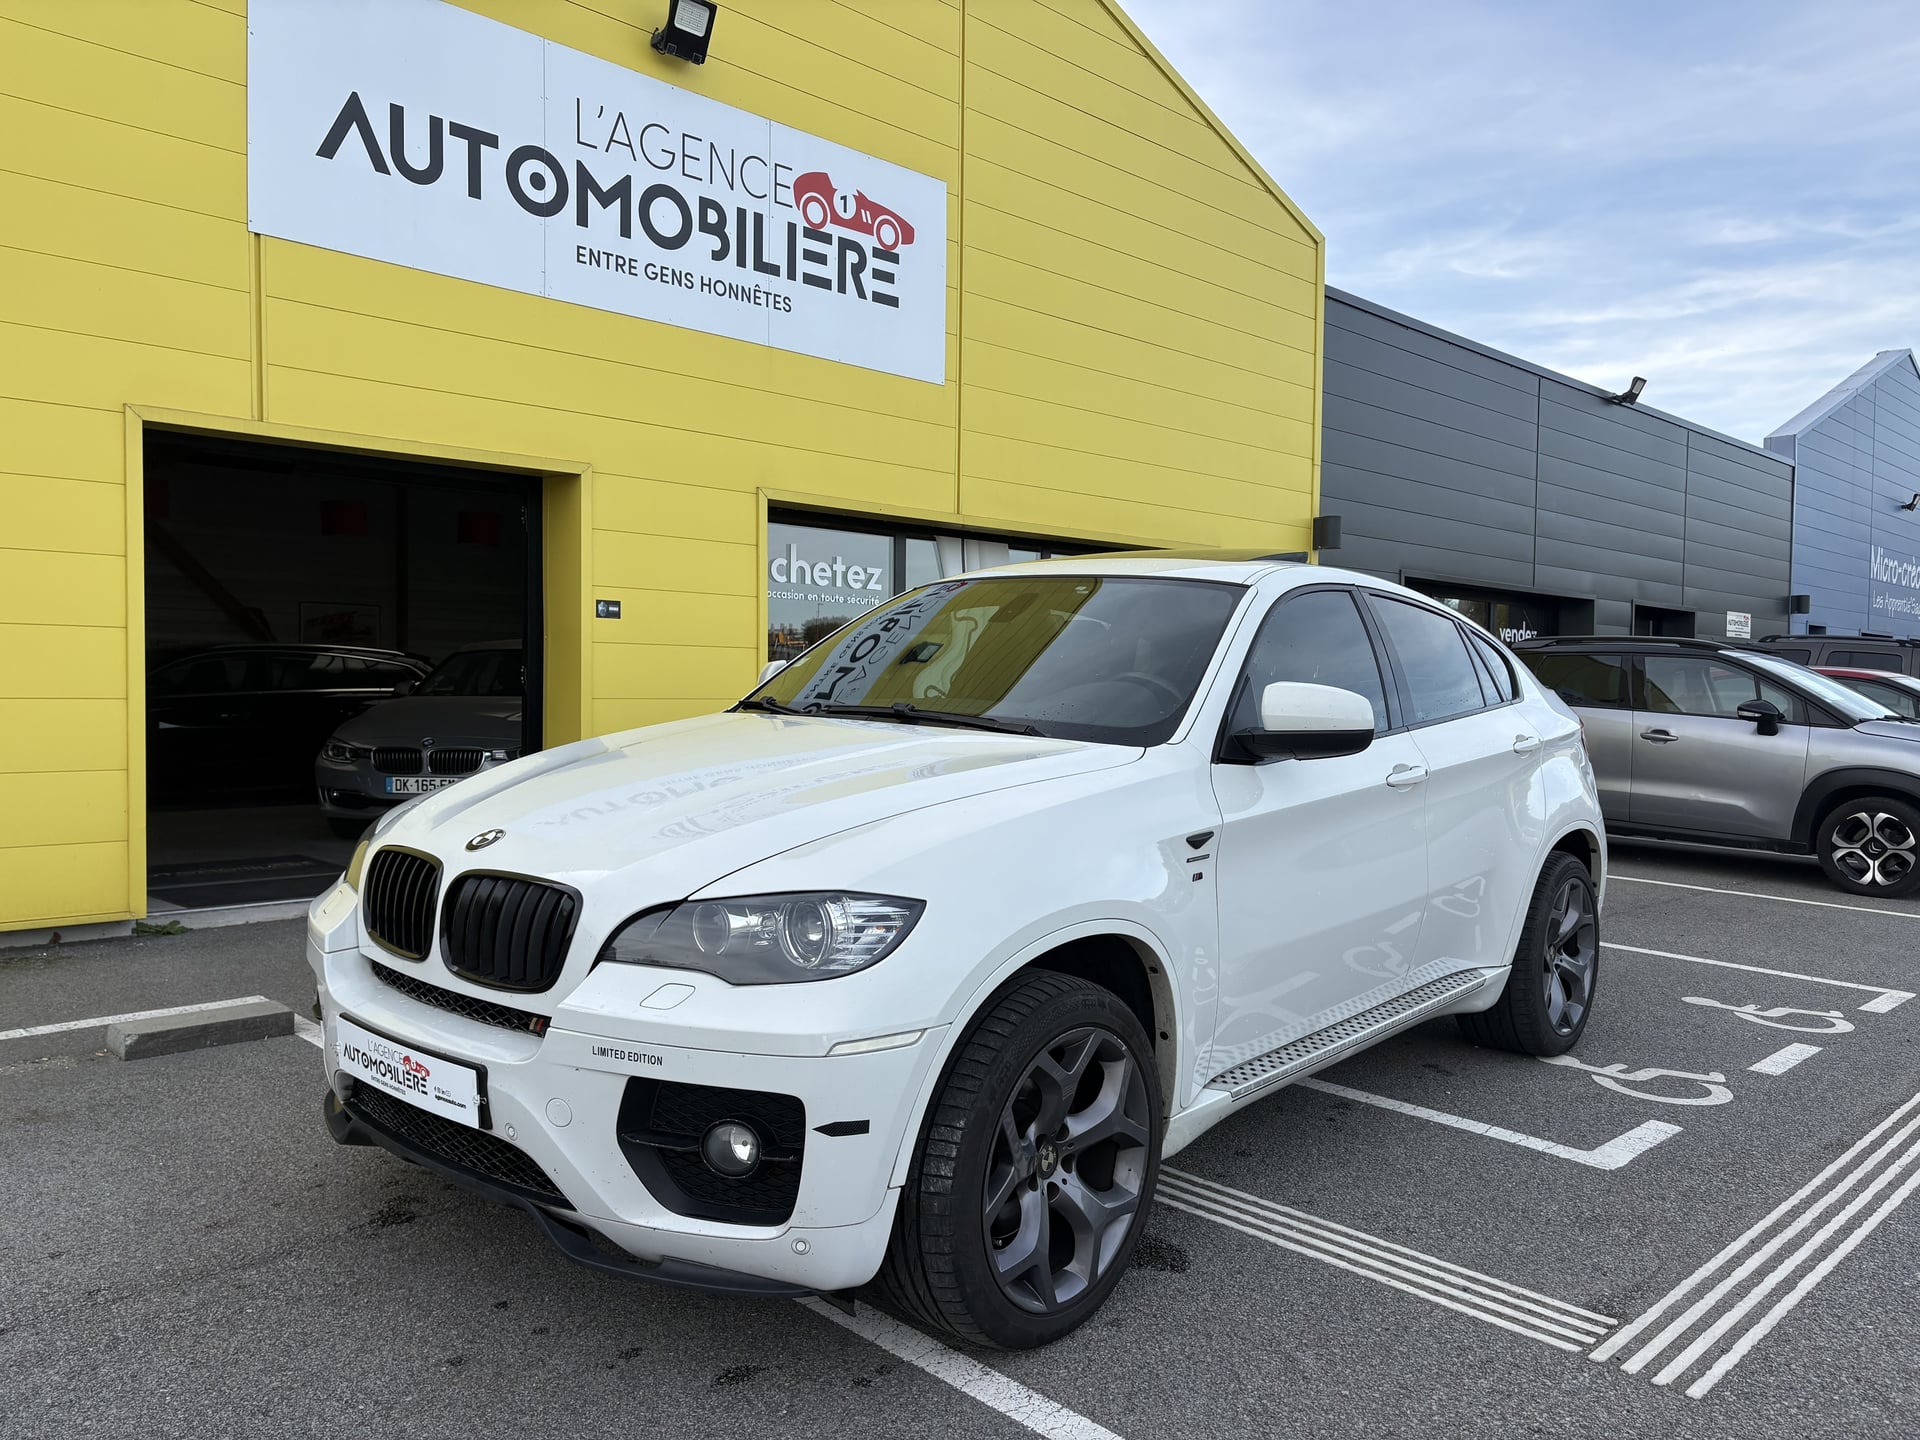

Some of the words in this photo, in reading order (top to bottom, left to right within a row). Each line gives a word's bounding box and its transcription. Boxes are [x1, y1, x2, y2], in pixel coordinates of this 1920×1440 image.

[575, 97, 793, 209] L'AGENCE
[315, 90, 900, 309] AUTOMOBILIERE
[839, 194, 848, 214] 1
[576, 245, 638, 276] ENTRE
[644, 262, 694, 290] GENS
[700, 276, 792, 313] HONNÊTES
[770, 543, 882, 591] chetez
[767, 589, 805, 600] occasion
[807, 592, 818, 601] en
[821, 593, 844, 603] toute
[847, 594, 880, 606] sécurité
[343, 1042, 428, 1096] AUTOMOBILIERE
[367, 1039, 404, 1066] L'AGENCE
[592, 1045, 626, 1060] LIMITED
[627, 1051, 663, 1066] EDITION
